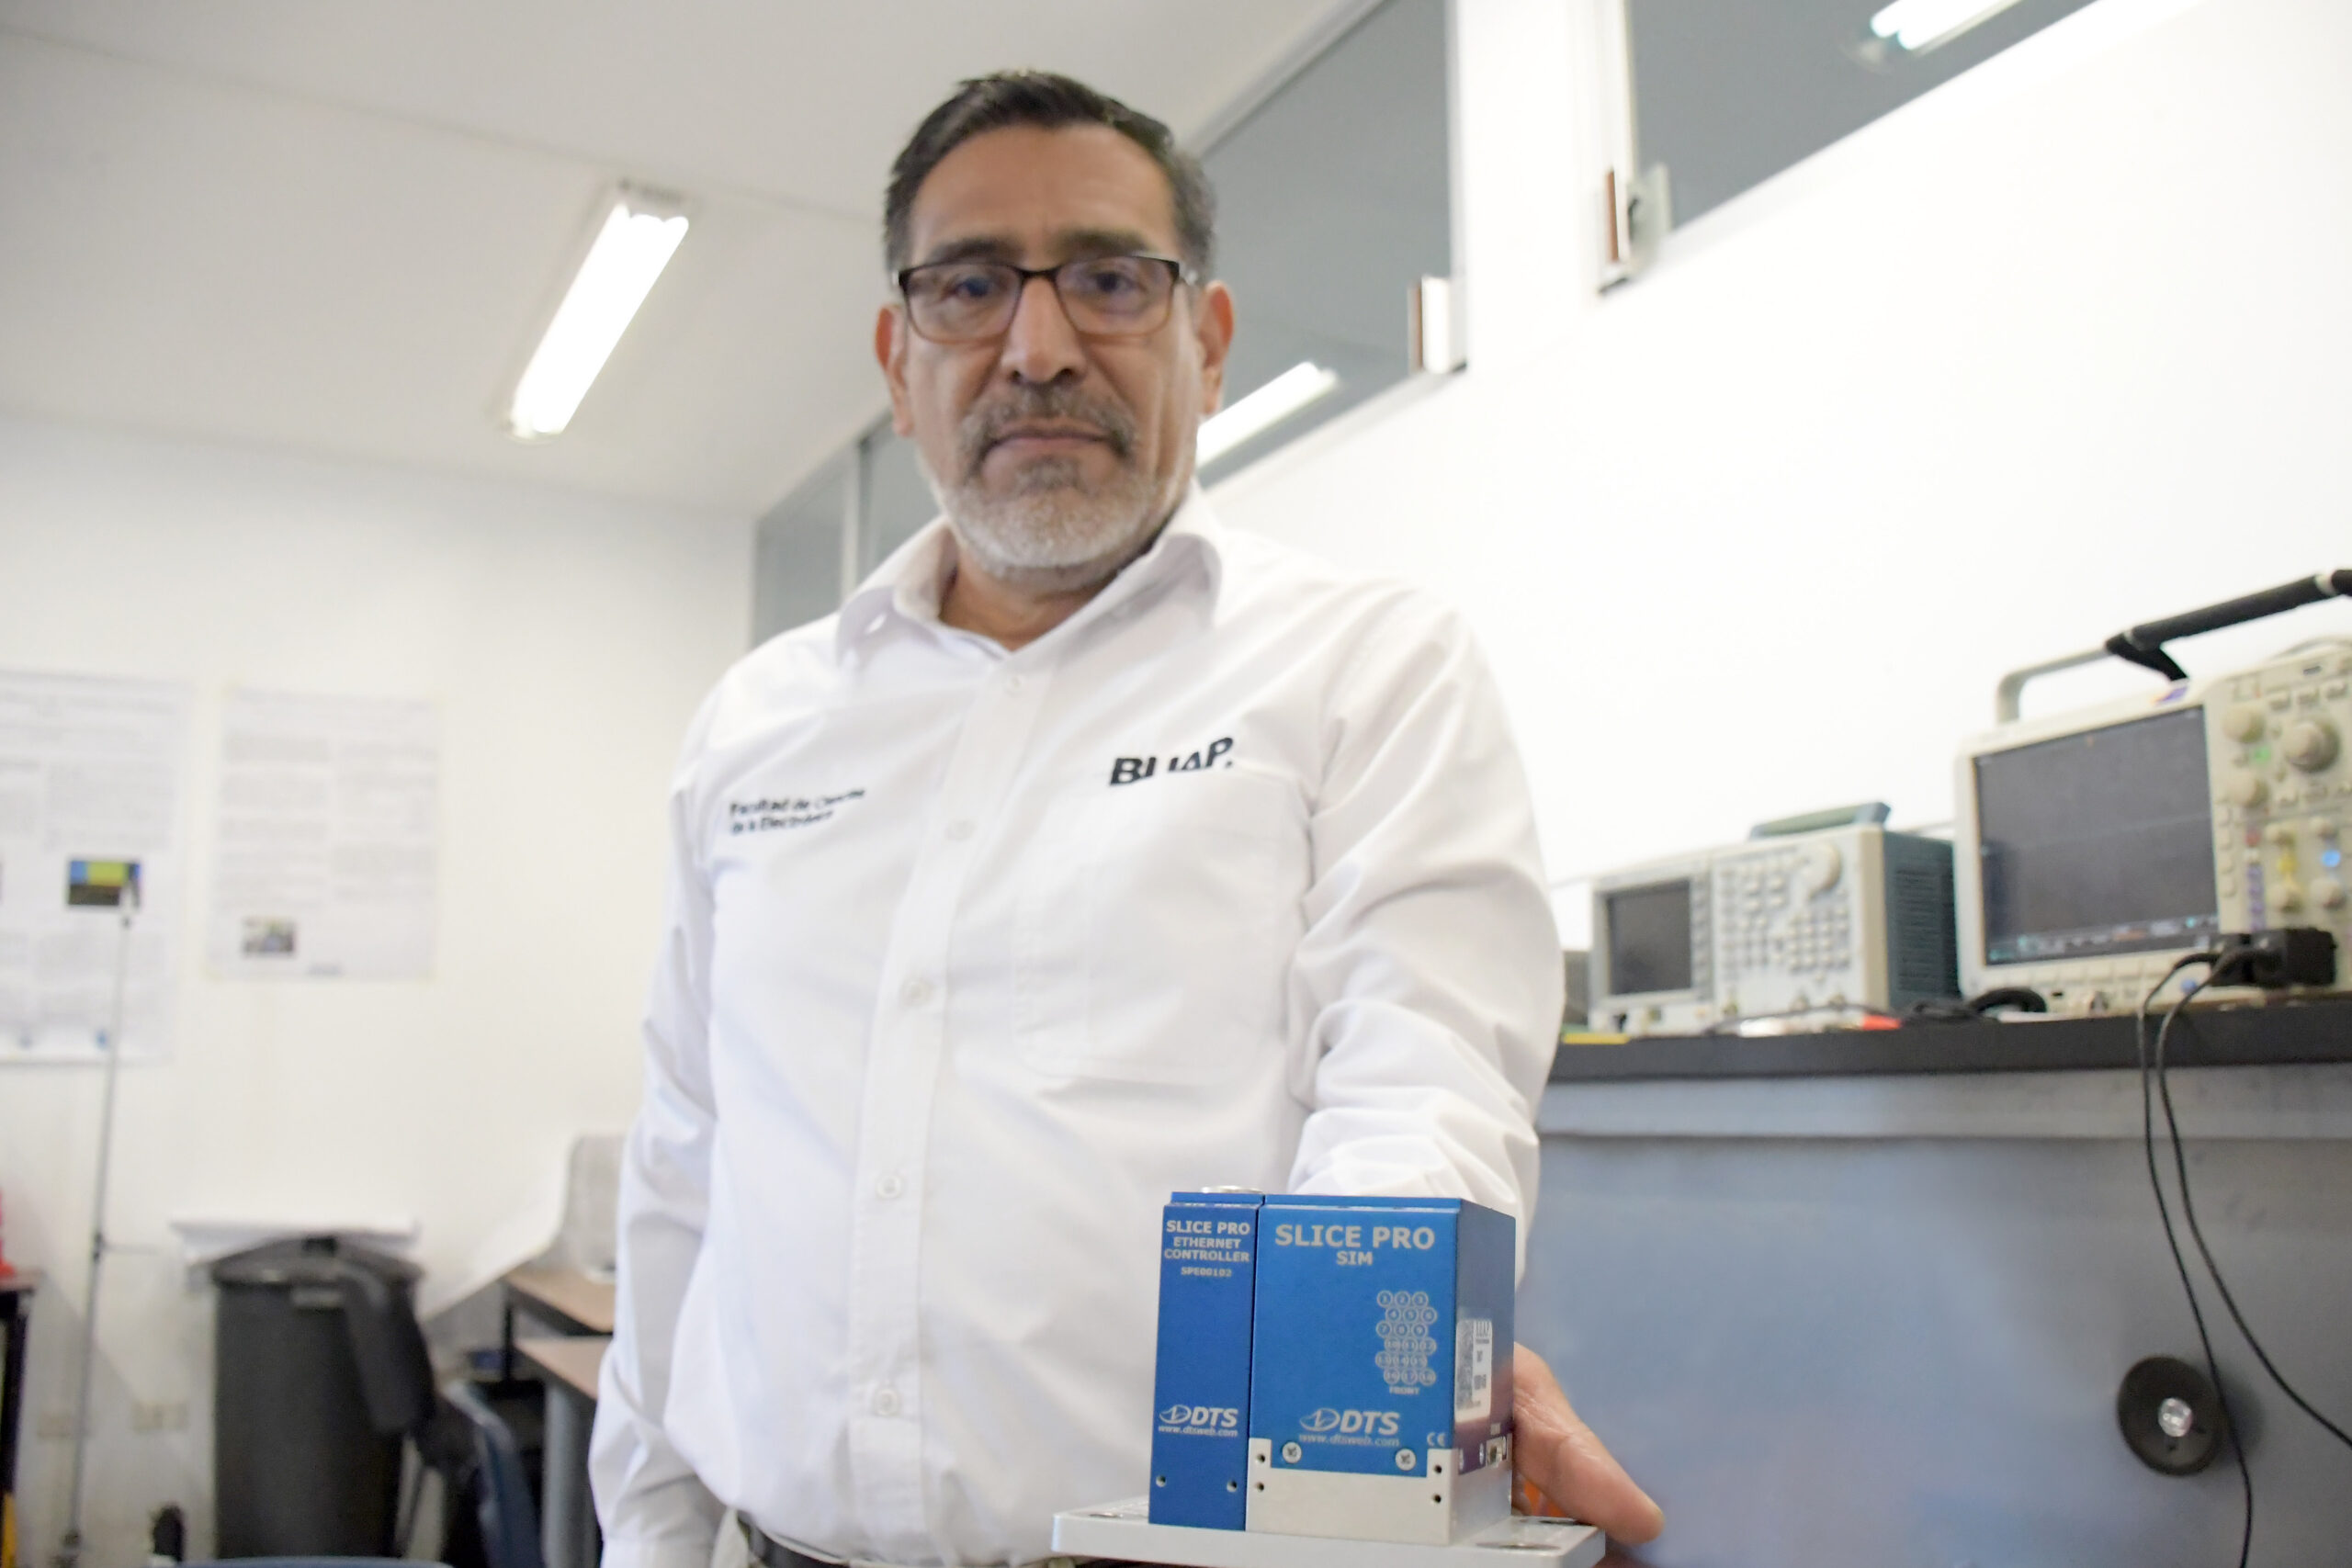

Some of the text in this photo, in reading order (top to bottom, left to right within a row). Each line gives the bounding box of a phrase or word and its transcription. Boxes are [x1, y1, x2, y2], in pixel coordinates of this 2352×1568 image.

[1166, 1220, 1250, 1235] SLICE PRO
[1173, 1236, 1241, 1249] ETHERNET
[1274, 1224, 1436, 1250] SLICE PRO
[1164, 1248, 1250, 1263] CONTROLLER
[1336, 1250, 1374, 1266] SIM
[1191, 1406, 1238, 1428] DTS
[1340, 1409, 1400, 1435] DTS
